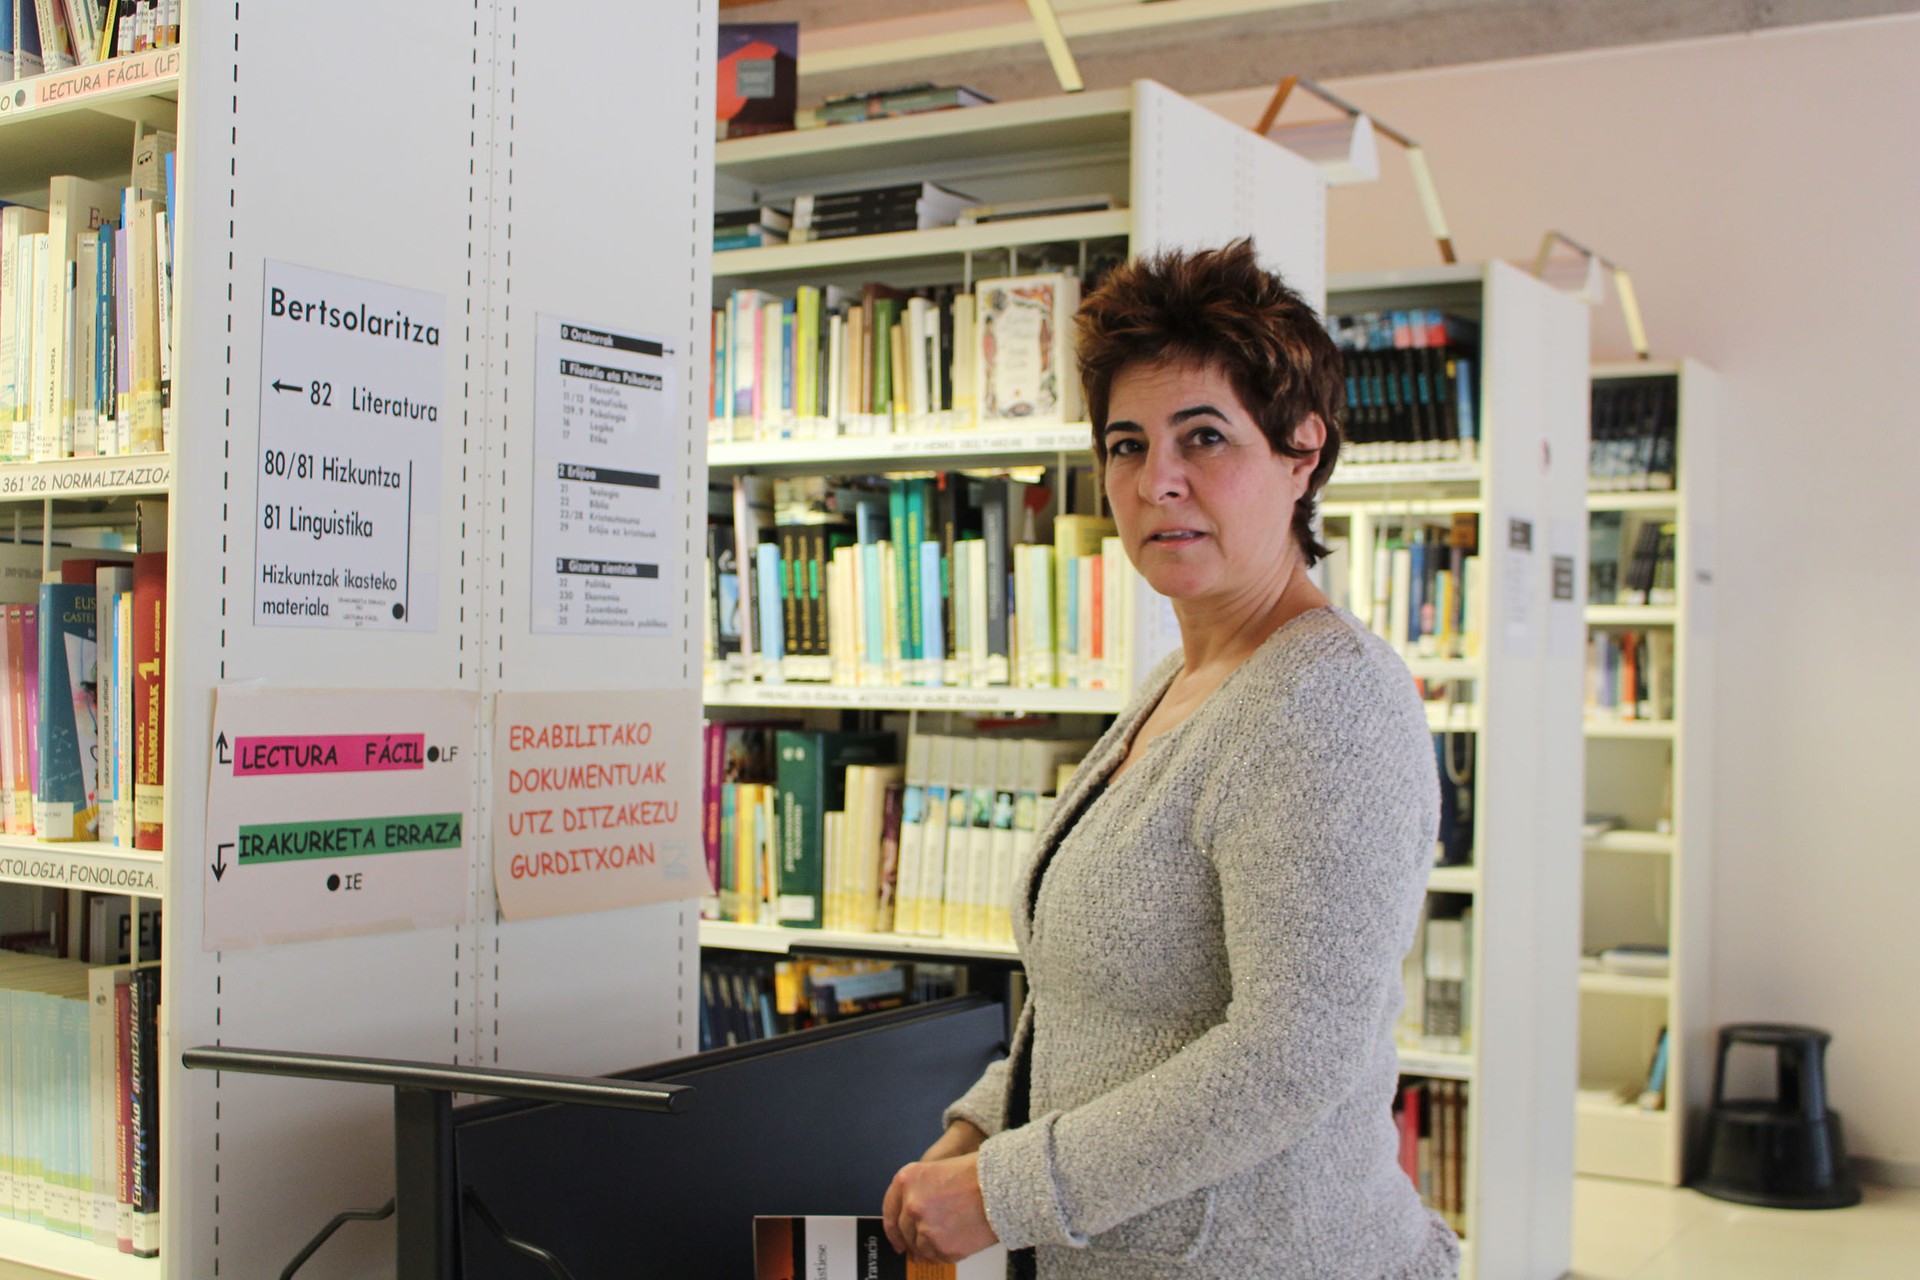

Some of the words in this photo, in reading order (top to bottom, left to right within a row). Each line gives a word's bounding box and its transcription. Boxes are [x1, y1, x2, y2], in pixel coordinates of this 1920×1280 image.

[42, 73, 101, 102] LECTURA
[107, 61, 149, 87] FÁCIL
[154, 52, 180, 76] (LF)
[271, 286, 440, 346] Bertsolaritza
[310, 380, 332, 407] 82
[352, 386, 437, 422] Literatura
[2, 474, 47, 493] 361'26
[264, 449, 314, 480] 80/81
[322, 456, 401, 489] Hizkuntza
[264, 503, 281, 530] 81
[289, 505, 373, 541] Linguistika
[262, 563, 340, 588] Hizkuntzak
[344, 568, 398, 591] ikasteko
[262, 596, 330, 617] materiala
[138, 657, 160, 681] 1
[242, 745, 338, 770] LECTURA
[365, 736, 424, 766] FÁCIL
[441, 746, 459, 763] LF
[509, 722, 653, 752] ERABILITAKO
[509, 761, 667, 794] DOKUMENTUAK
[509, 809, 554, 836] UTZ
[562, 800, 679, 832] DITZAKEZU
[239, 827, 376, 858] IRAKURKETA
[384, 822, 462, 847] ERRAZA
[511, 841, 656, 880] GURDITXOAN
[344, 873, 363, 891] IE
[129, 982, 141, 1094] arrotzhitzak
[131, 1102, 142, 1207] Euskarazko
